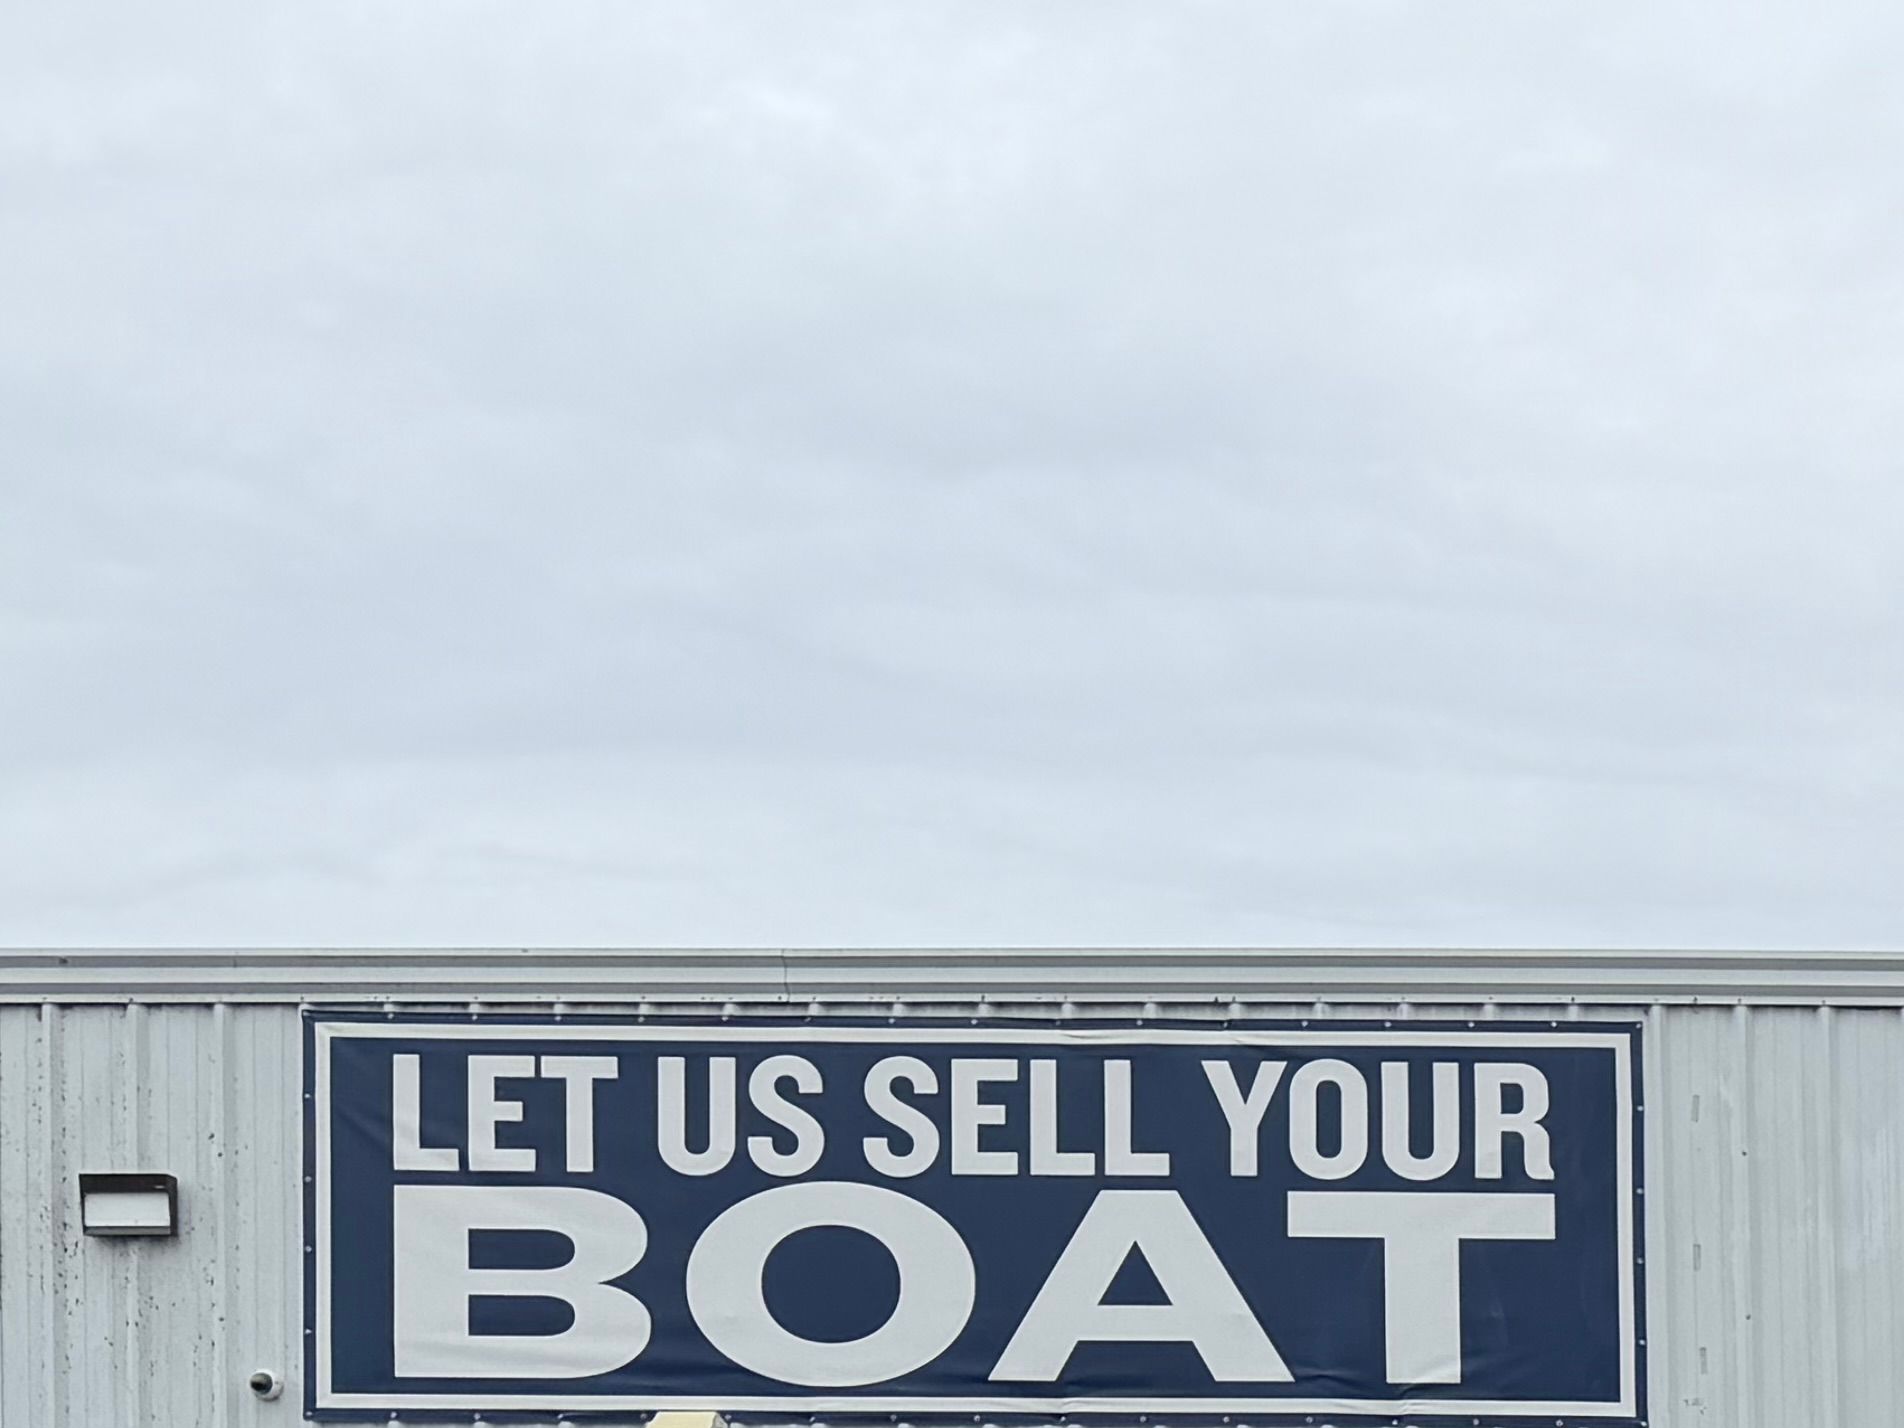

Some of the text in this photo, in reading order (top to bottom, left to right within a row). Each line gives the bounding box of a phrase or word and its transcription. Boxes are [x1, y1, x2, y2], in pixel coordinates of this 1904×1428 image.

[393, 1053, 1556, 1181] LET US SELL YOUR
[393, 1180, 1556, 1388] BOAT
